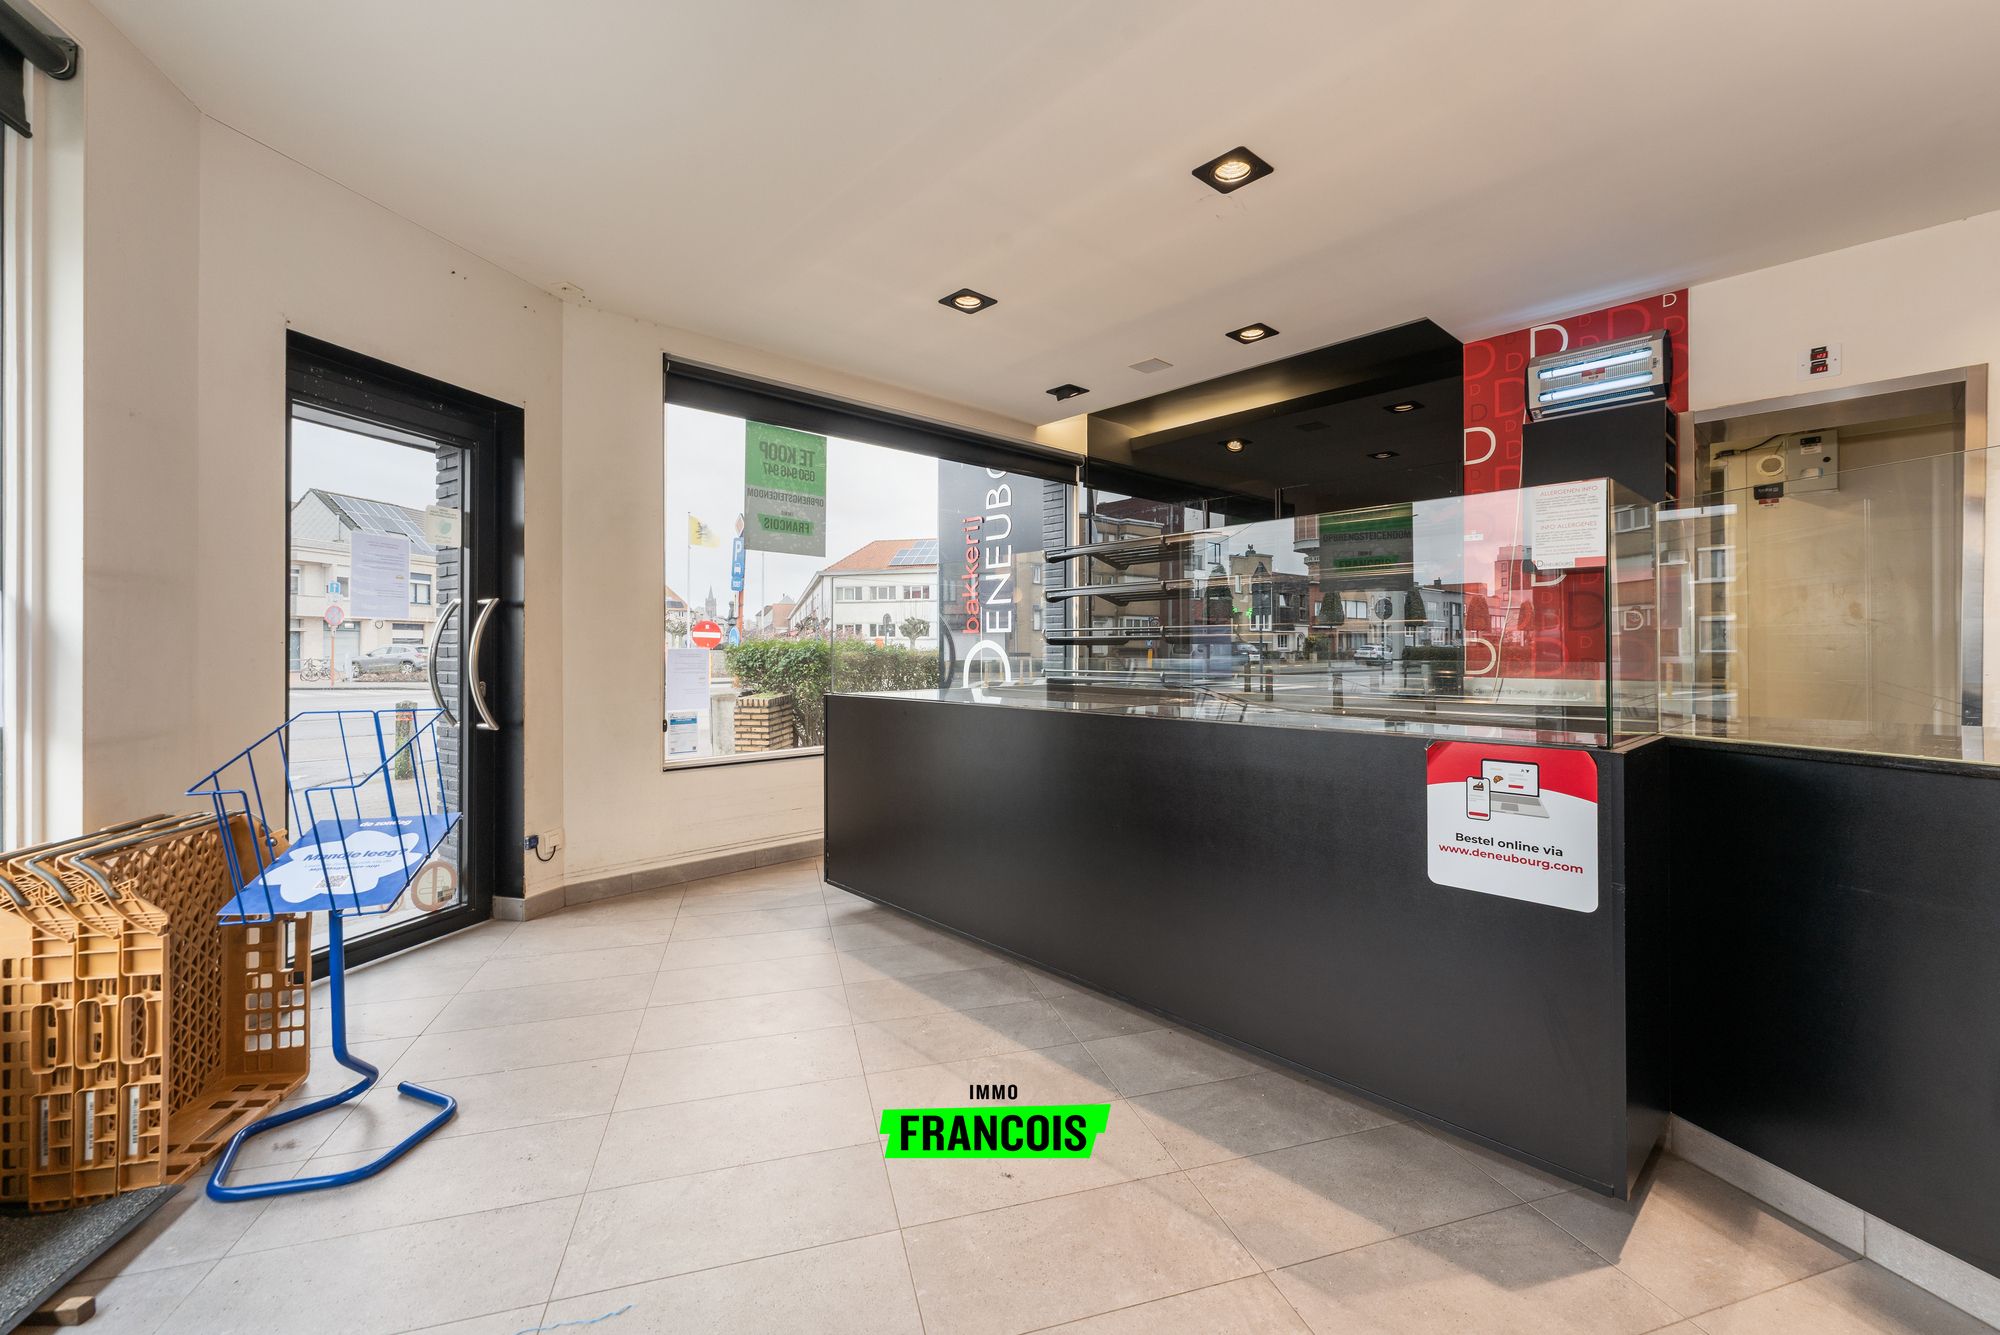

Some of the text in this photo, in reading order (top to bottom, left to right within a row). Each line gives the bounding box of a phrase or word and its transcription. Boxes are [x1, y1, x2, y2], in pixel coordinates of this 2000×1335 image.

[1540, 485, 1598, 497] ALLERGENEN INFO
[963, 515, 985, 635] bakkerij
[1438, 843, 1584, 874] www.deneubourg.com
[1455, 832, 1563, 857] Bestel online via
